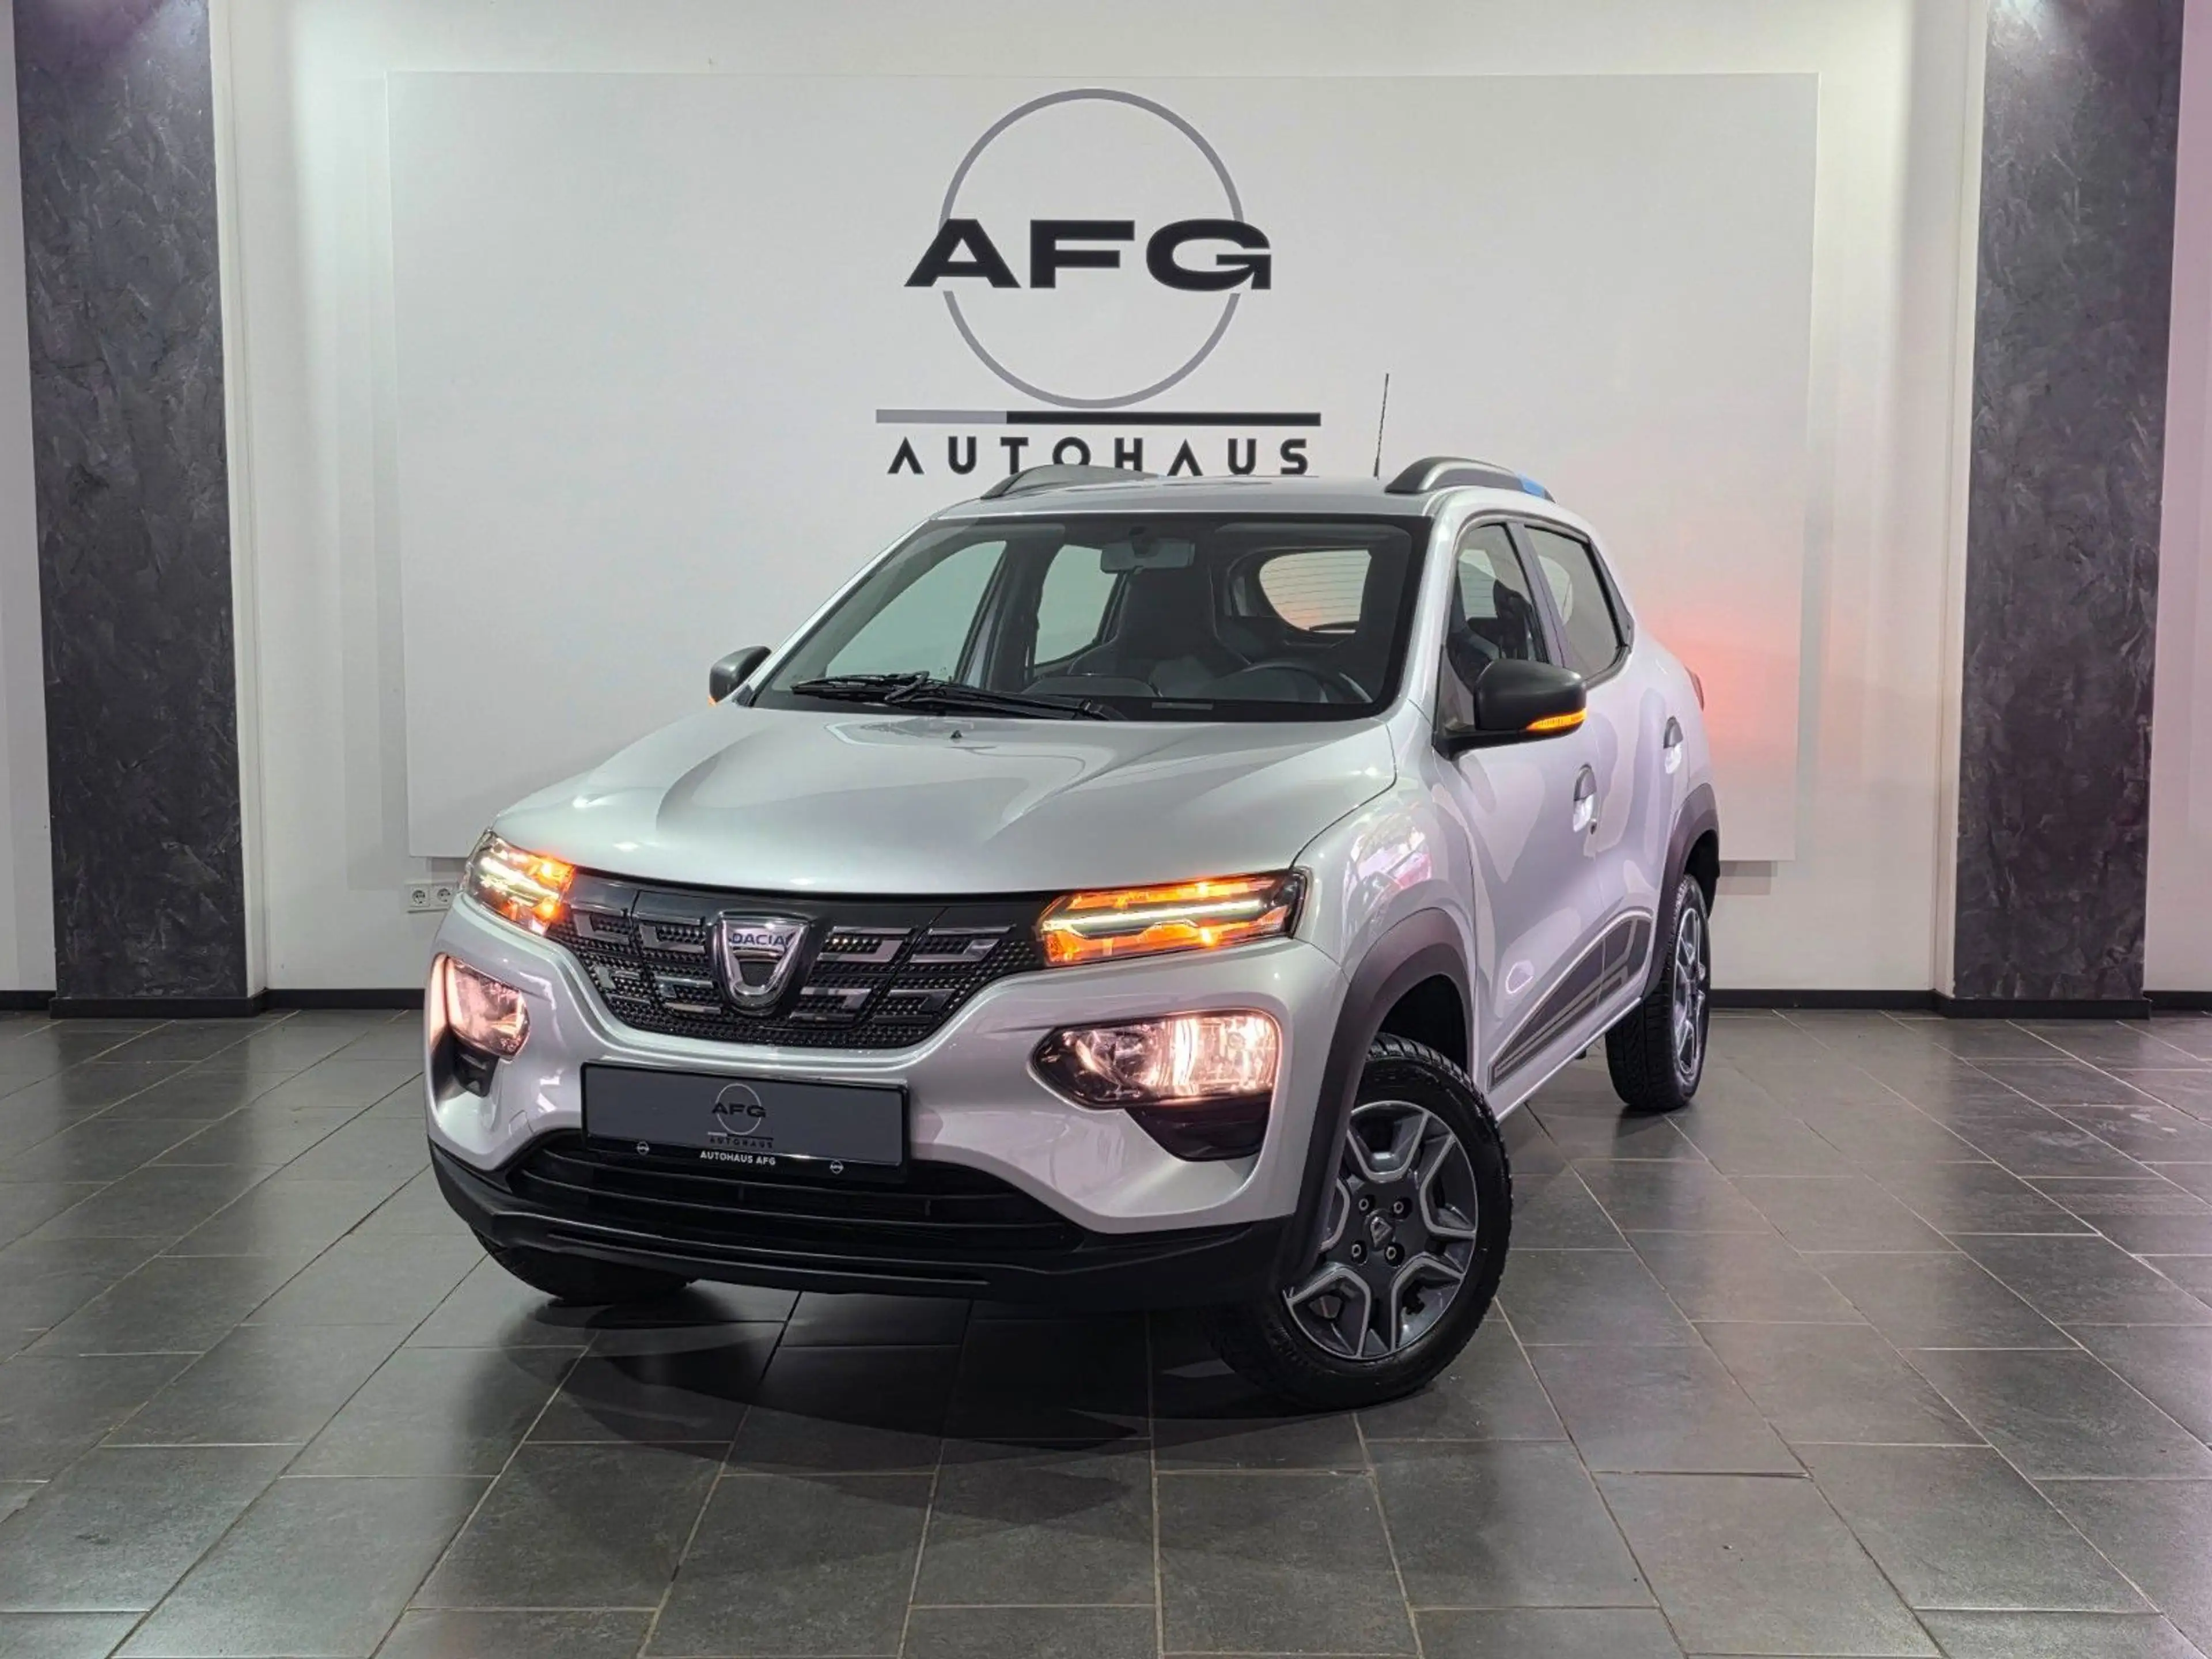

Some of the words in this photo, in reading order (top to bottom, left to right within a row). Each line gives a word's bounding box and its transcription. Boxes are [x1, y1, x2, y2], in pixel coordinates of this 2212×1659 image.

[904, 218, 1271, 291] AFG
[887, 436, 1308, 476] AUTOHAUS
[732, 933, 785, 946] DACIA
[711, 1103, 766, 1118] AFG
[710, 1137, 773, 1149] AUTOHAUS
[700, 1150, 753, 1163] AUTOHAUS
[756, 1155, 777, 1165] AFG
